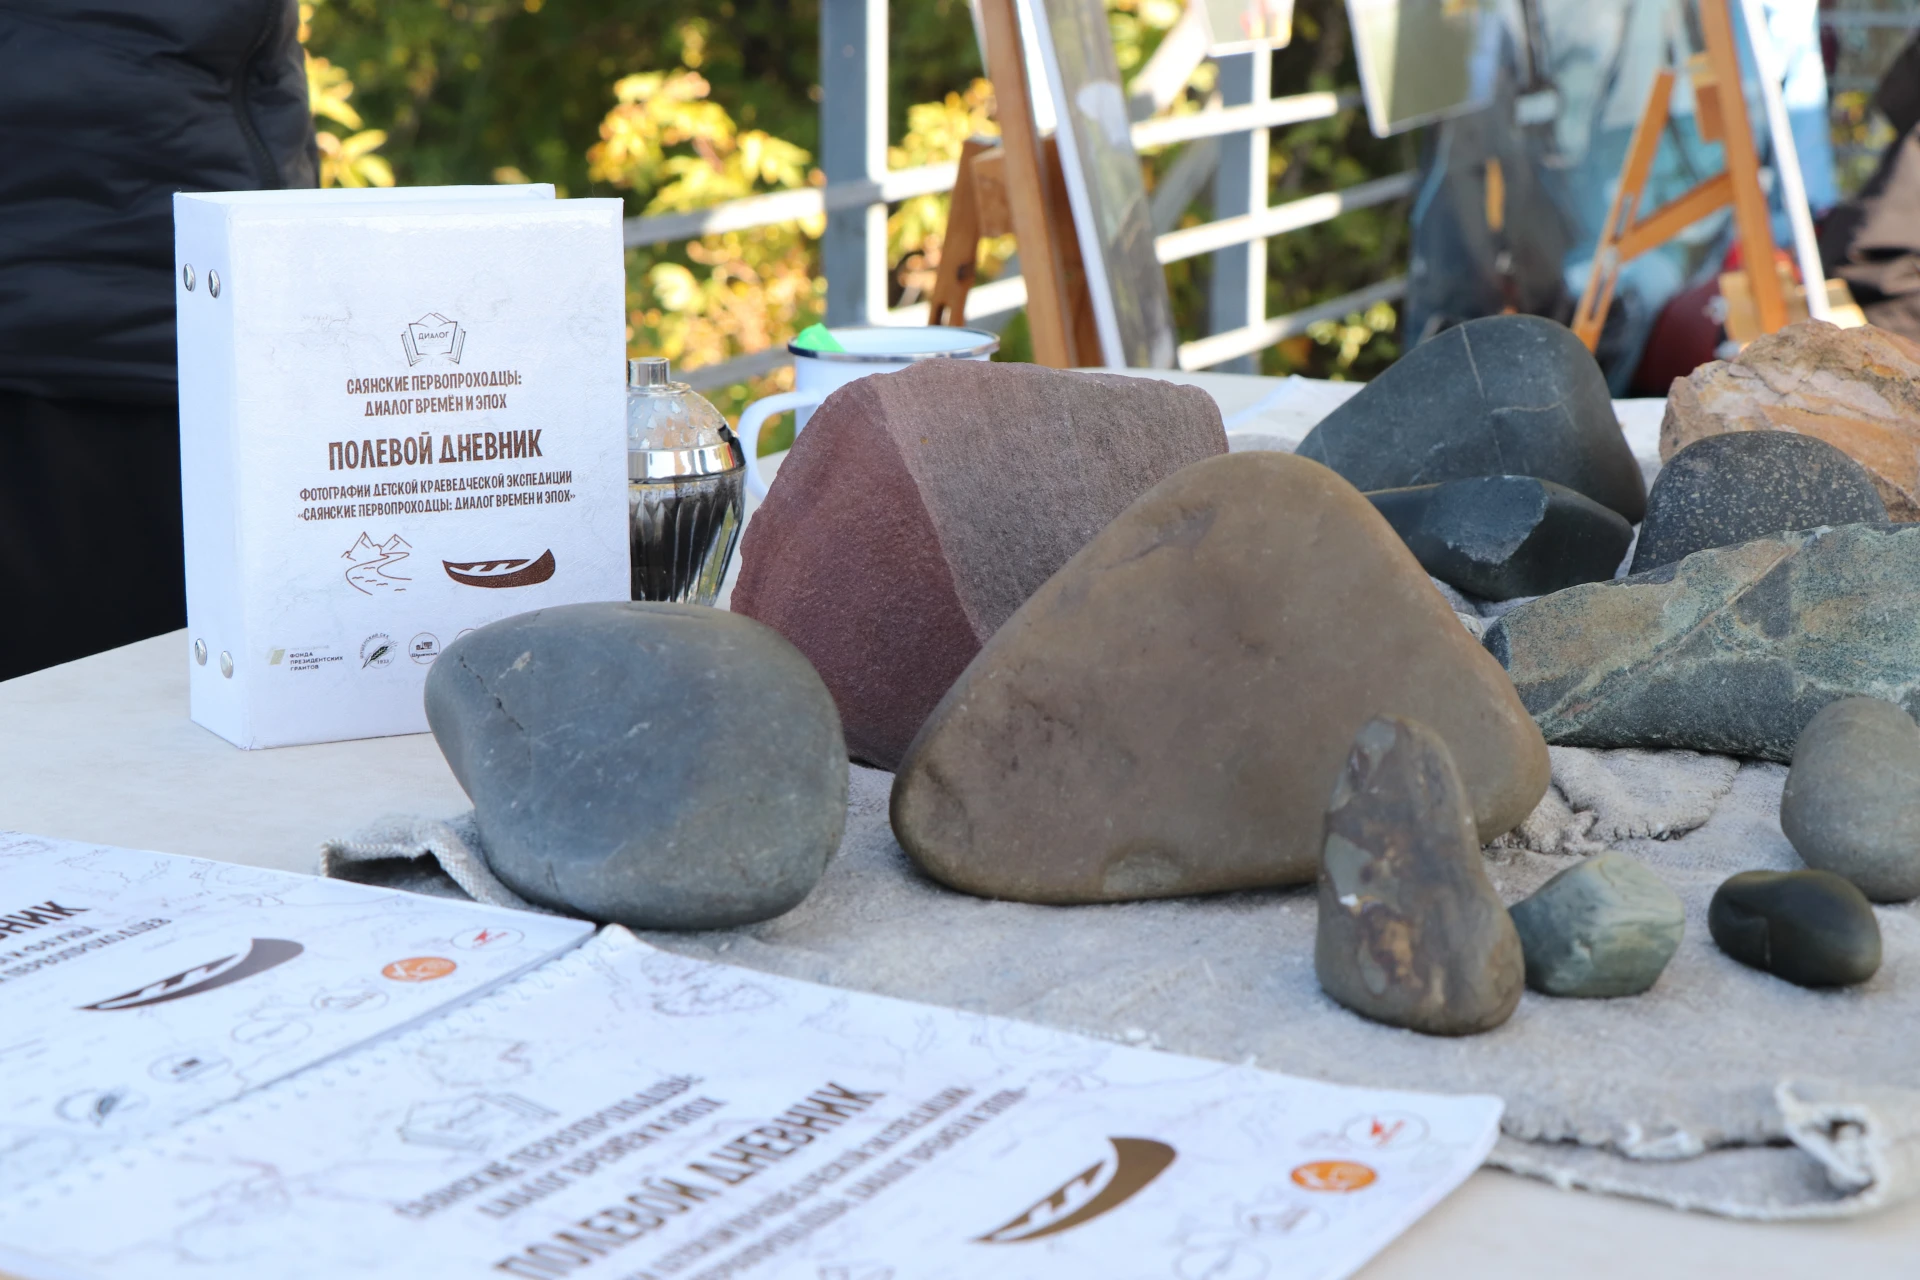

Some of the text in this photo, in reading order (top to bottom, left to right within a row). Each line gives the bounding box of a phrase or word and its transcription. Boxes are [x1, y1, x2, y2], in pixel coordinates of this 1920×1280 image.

[418, 331, 450, 340] ДИАЛОГ
[346, 370, 522, 395] САЯНСКИЕ ПЕРВОПРОХОДЦЫ:
[364, 393, 507, 417] ДИАЛОГ ВРЕМЁН И ЭПОХ
[328, 428, 543, 471] ПОЛЕВОЙ ДНЕВНИК
[299, 470, 573, 501] ФОТОГРАФИИ ДЕТСКОЙ КРАЕВЕДЧЕСКОЙ ЭКСПЕДИЦИИ
[298, 489, 576, 521] «САЯНСКИЕ ПЕРВОПРОХОДЦЫ: ДИАЛОГ ВРЕМЕН И ЭПОХ»
[289, 651, 314, 659] ФОНДА
[290, 655, 344, 665] ПРЕЗИДЕНТСКИХ
[493, 1176, 723, 1280] ПОЛЕВОЙ
[687, 1081, 886, 1186] ДНЕВНИК
